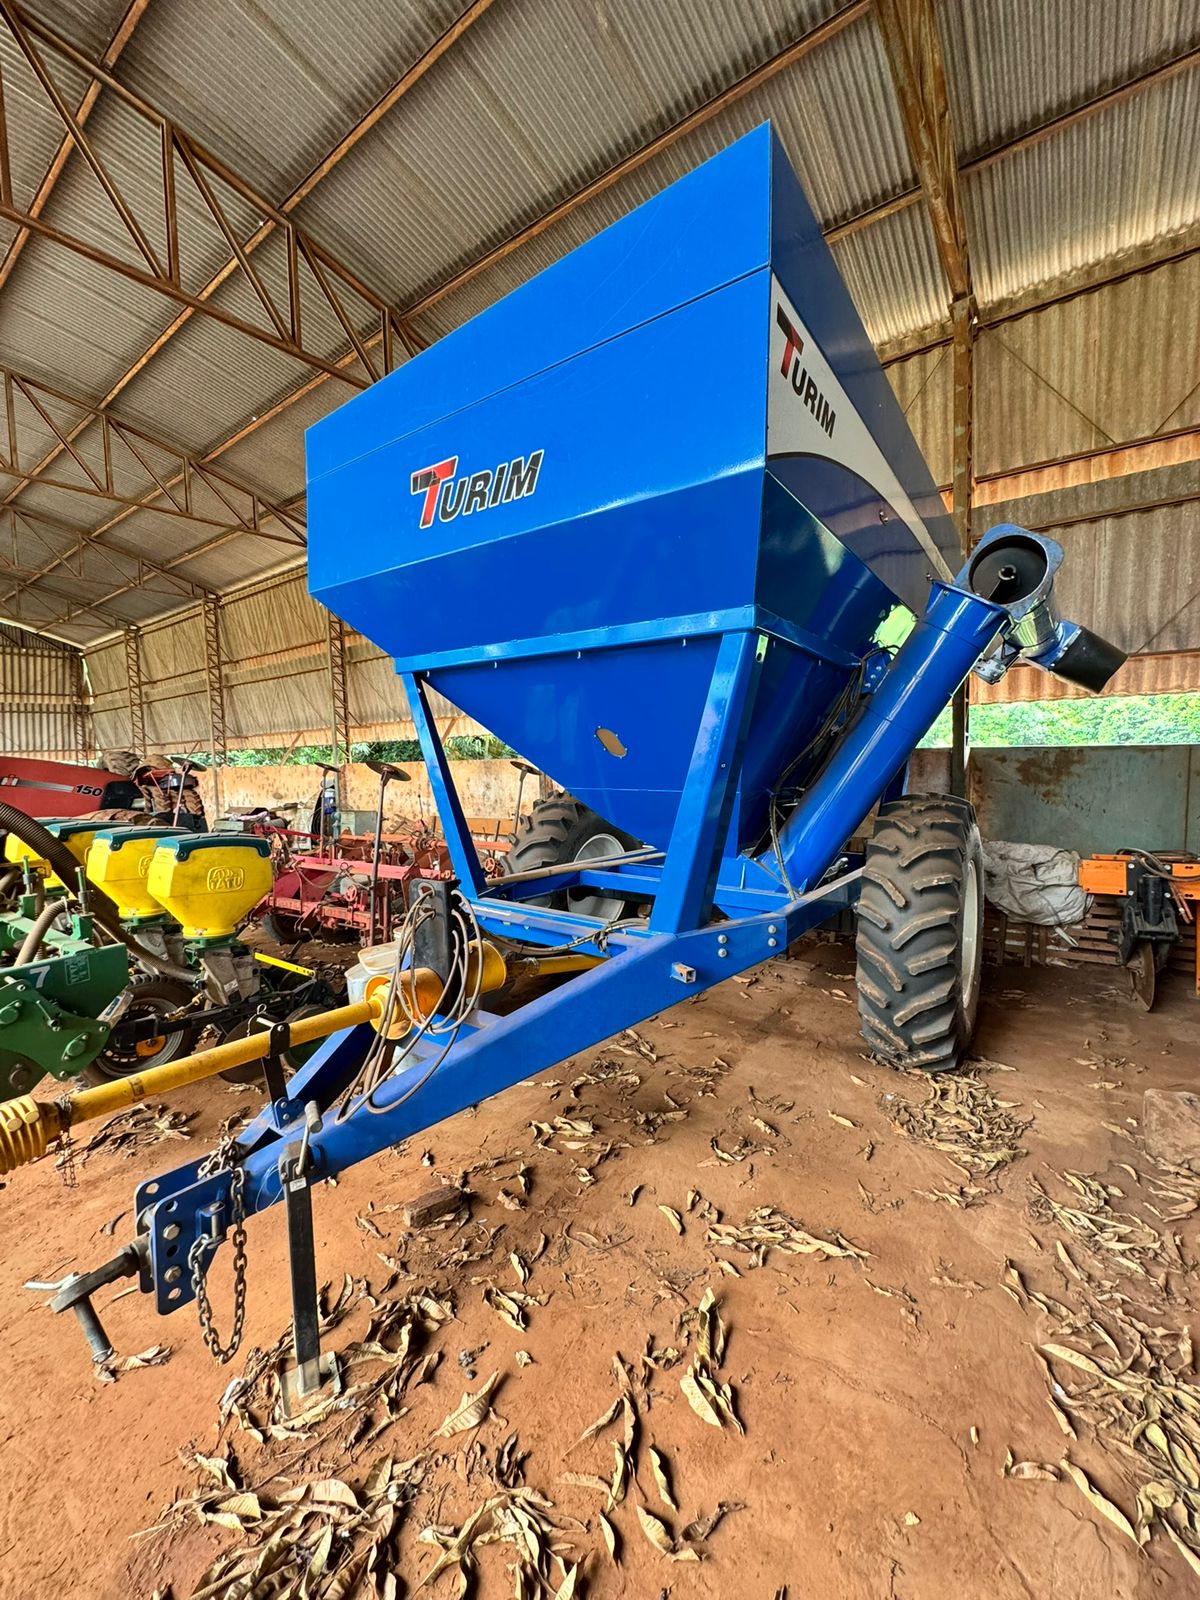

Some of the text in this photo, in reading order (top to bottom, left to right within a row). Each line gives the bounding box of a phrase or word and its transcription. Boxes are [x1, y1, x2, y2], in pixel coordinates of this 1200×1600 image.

[777, 302, 836, 438] TURIM
[411, 449, 544, 529] TURIM
[75, 785, 103, 797] 150
[29, 965, 51, 988] 7
